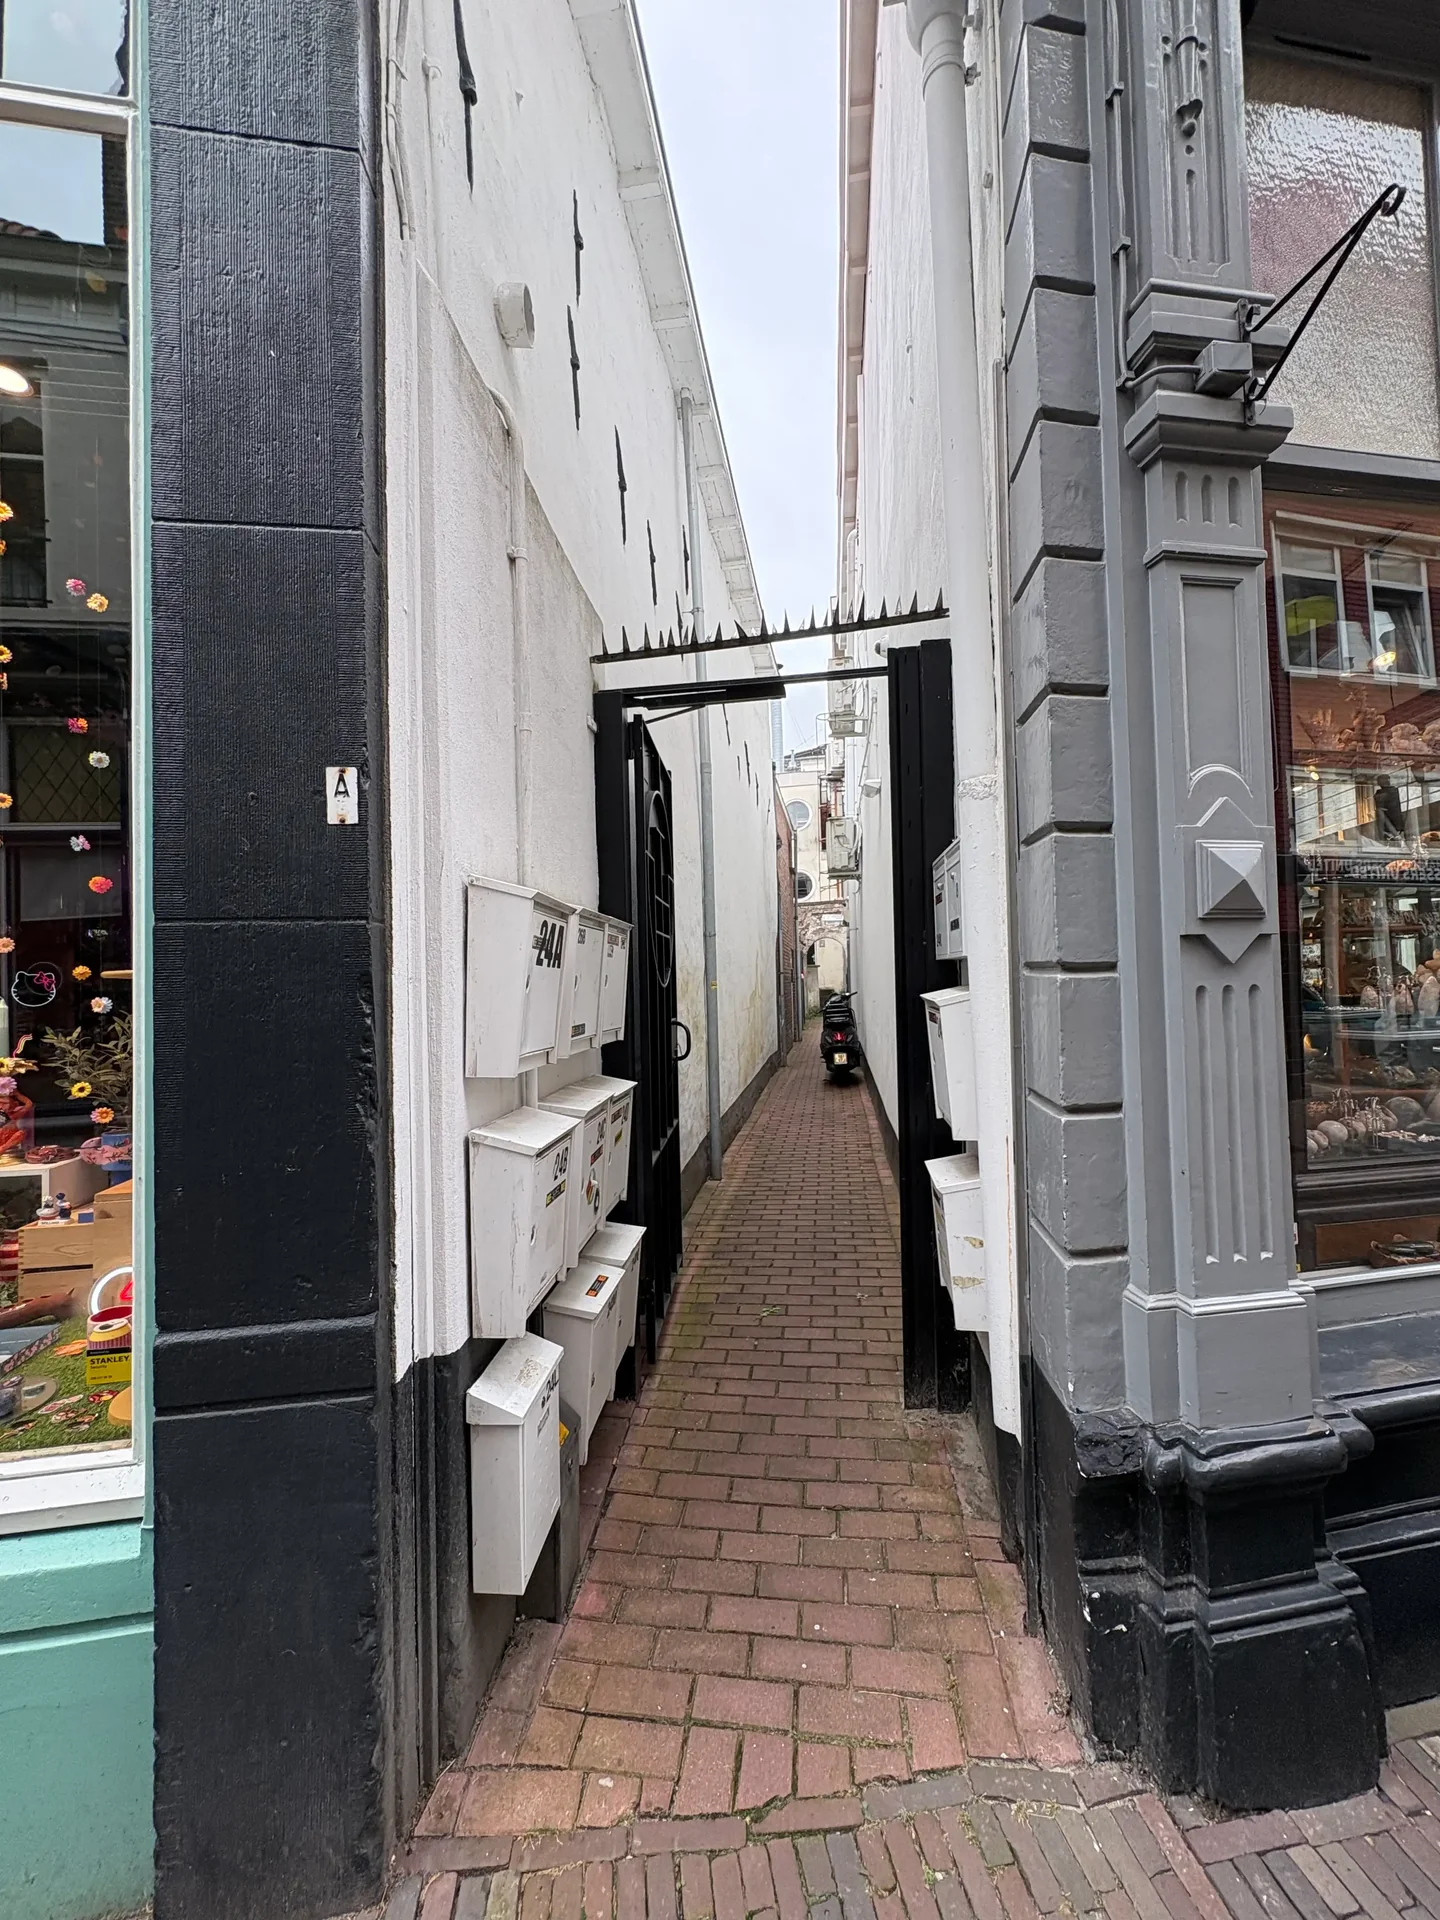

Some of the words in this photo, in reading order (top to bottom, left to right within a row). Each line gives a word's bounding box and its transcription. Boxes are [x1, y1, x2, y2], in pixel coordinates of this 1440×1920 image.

[334, 773, 350, 798] A
[535, 919, 565, 969] 24A
[553, 1146, 569, 1182] 24B
[90, 1355, 130, 1365] STANLEY
